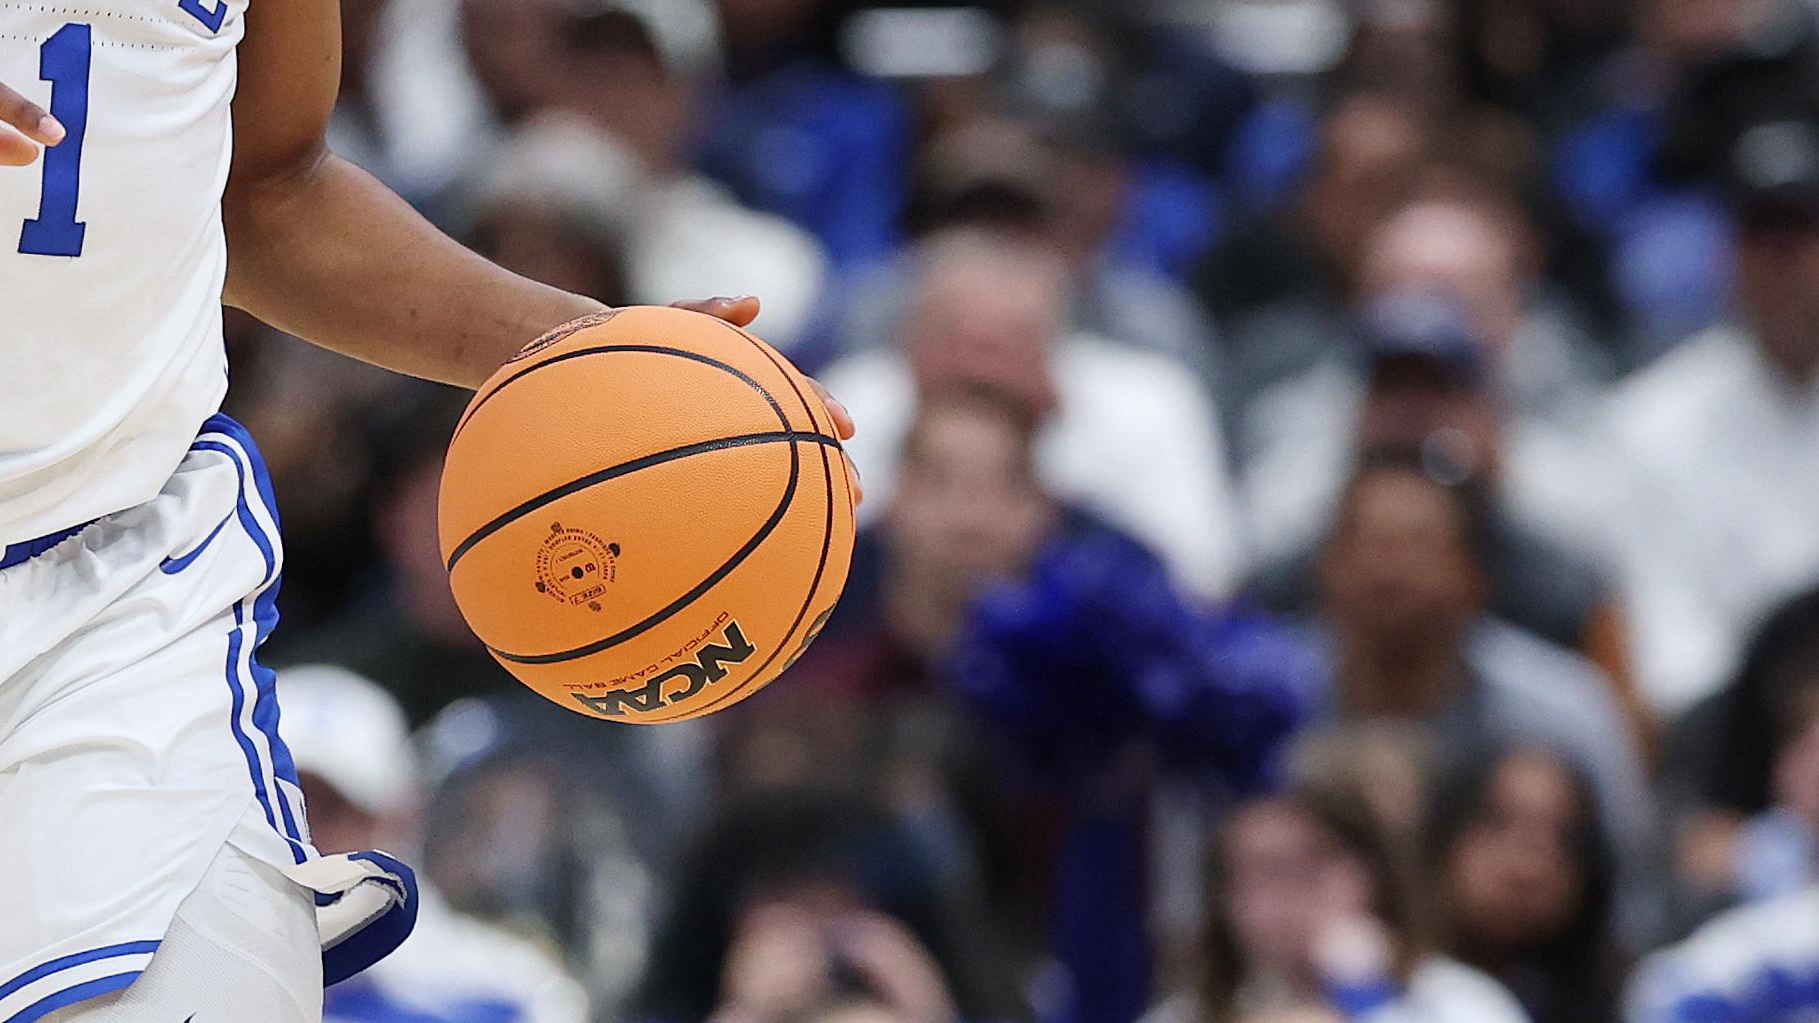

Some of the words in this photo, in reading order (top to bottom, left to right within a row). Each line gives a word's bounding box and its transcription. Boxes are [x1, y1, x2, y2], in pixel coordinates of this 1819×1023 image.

[18, 23, 91, 257] 1
[661, 611, 729, 663] OFFICIAL
[563, 681, 609, 691] BALL
[570, 619, 757, 716] NCAA
[611, 664, 659, 684] GAME
